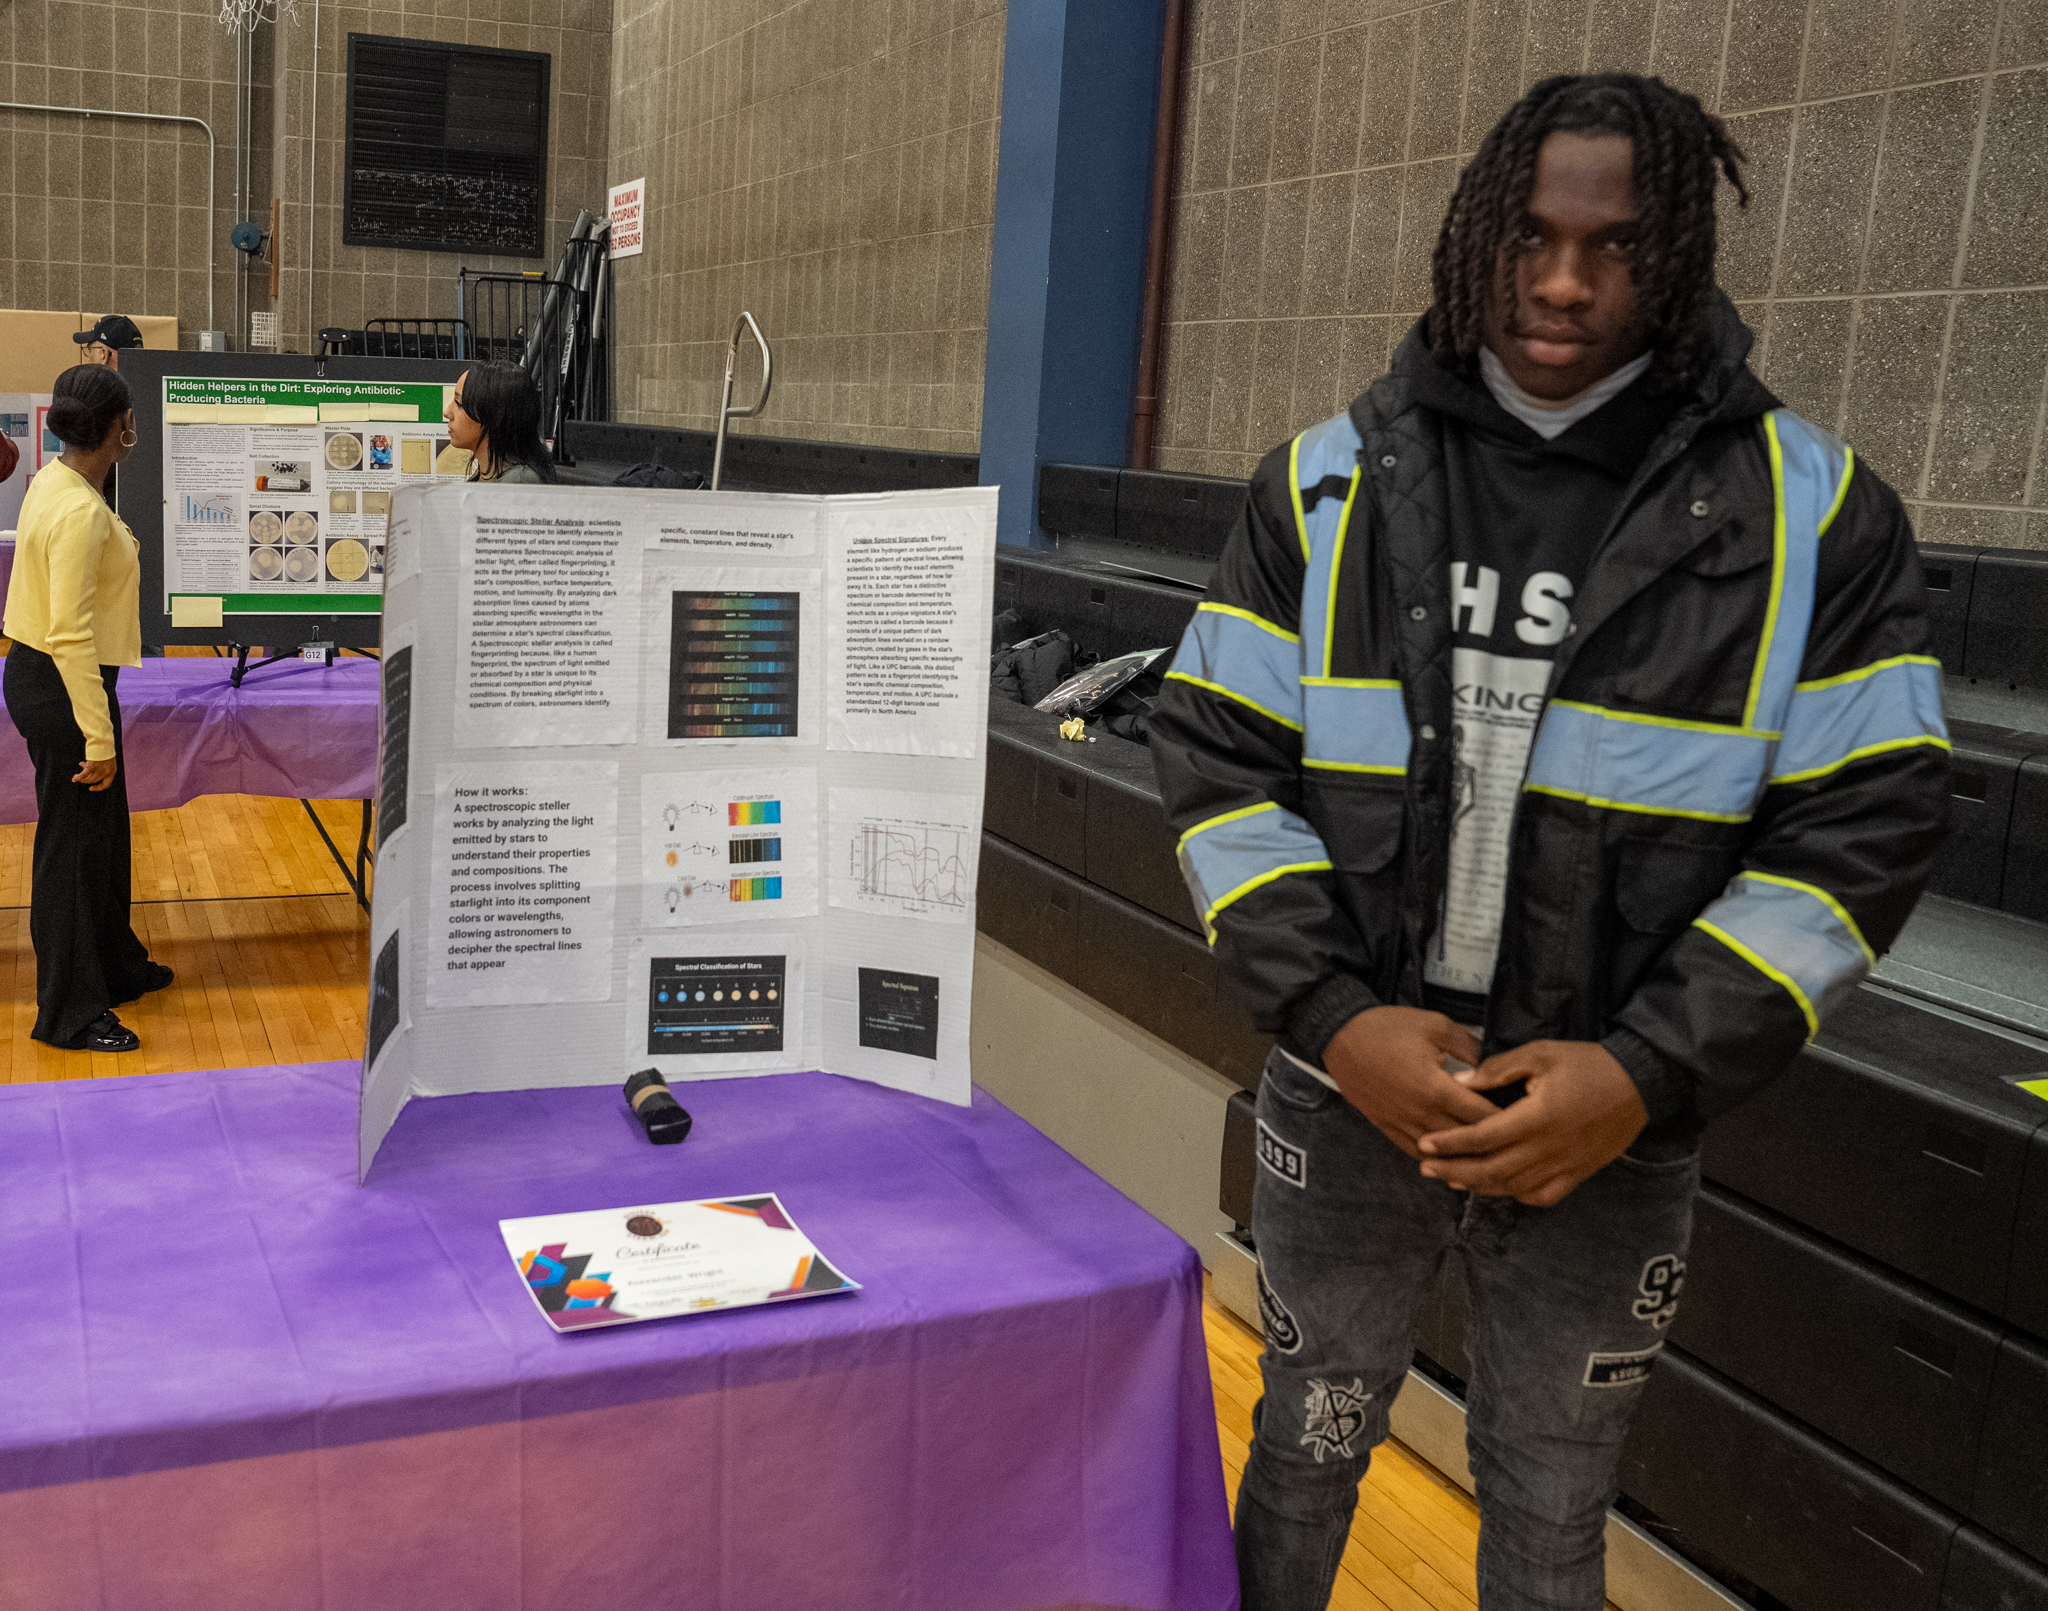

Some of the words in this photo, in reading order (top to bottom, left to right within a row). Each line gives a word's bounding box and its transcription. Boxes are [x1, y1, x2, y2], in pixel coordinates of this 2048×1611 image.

[614, 189, 638, 207] MAXIMUM
[611, 204, 641, 224] OCCUPANCY
[625, 221, 638, 232] EXCEED
[618, 232, 641, 249] PERSONS
[169, 381, 205, 390] Hidden
[208, 382, 246, 393] Helpers
[249, 382, 258, 391] in
[261, 383, 277, 392] the
[280, 383, 301, 392] Dirt:
[304, 384, 352, 396] Exploring
[354, 385, 404, 395] Antibiotic-
[169, 393, 222, 404] Producing
[224, 394, 266, 404] Bacteria
[476, 517, 529, 526] Spectroscopic
[498, 527, 546, 536] spectroscope
[556, 528, 582, 537] identify
[660, 526, 688, 536] specific,
[690, 528, 719, 536] constant
[750, 530, 770, 538] reveal
[476, 536, 506, 544] different
[508, 537, 527, 546] types
[572, 540, 602, 548] compare
[660, 536, 691, 546] elements,
[693, 538, 733, 548] temperature,
[749, 540, 773, 550] density.
[853, 538, 873, 546] Unique
[874, 537, 898, 545] Spectral
[931, 535, 947, 543] Every
[881, 546, 908, 554] hydrogen
[938, 545, 963, 553] produces
[306, 651, 320, 659] G12
[454, 787, 479, 797] How
[482, 787, 489, 796] it
[492, 786, 528, 796] works:
[453, 803, 462, 812] A
[464, 801, 536, 814] spectroscopic
[539, 800, 569, 810] steller
[453, 818, 485, 828] works
[486, 818, 500, 830] by
[501, 816, 550, 829] analyzing
[553, 816, 569, 826] the
[572, 815, 594, 828] light
[452, 834, 492, 844] emitted
[494, 833, 507, 845] by
[510, 833, 535, 842] stars
[538, 832, 548, 842] to
[451, 849, 511, 860] understand
[512, 849, 536, 858] their
[539, 847, 590, 860] properties
[451, 866, 471, 876] and
[472, 864, 544, 878] compositions.
[550, 864, 568, 873] The
[450, 884, 492, 894] process
[494, 880, 536, 890] involves
[540, 879, 580, 892] splitting
[450, 897, 493, 910] starlight
[495, 896, 516, 906] into
[518, 896, 531, 905] its
[534, 894, 590, 907] component
[449, 913, 481, 923] colors
[498, 910, 563, 924] wavelengths,
[448, 928, 492, 941] allowing
[494, 926, 559, 937] astronomers
[562, 925, 571, 934] to
[448, 943, 492, 956] decipher
[495, 943, 512, 952] the
[515, 941, 556, 954] spectral
[558, 940, 582, 950] lines
[447, 960, 468, 970] that
[470, 961, 505, 971] appear
[675, 964, 700, 972] Spectral
[616, 1241, 701, 1260] Certificate
